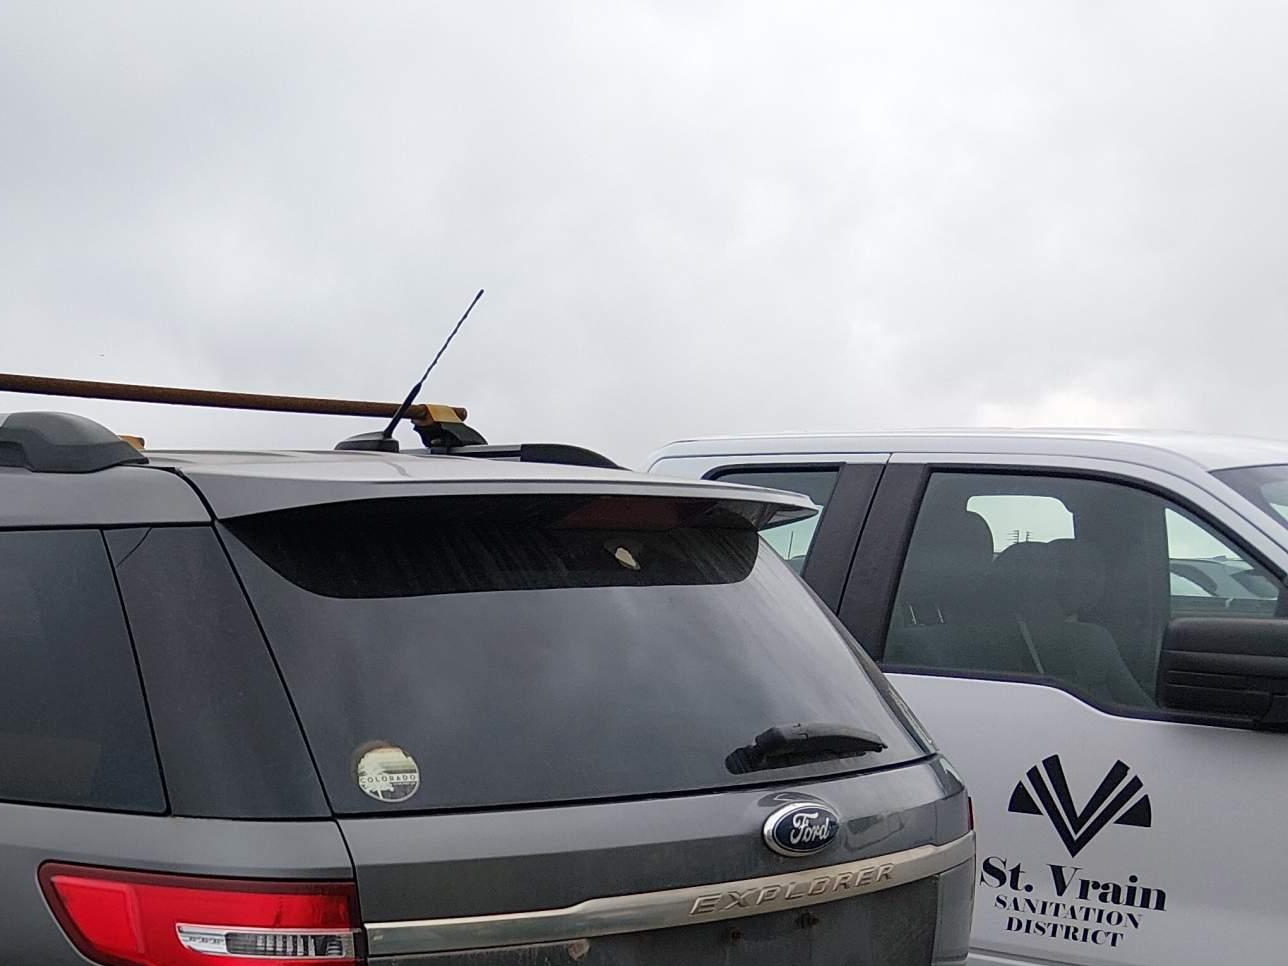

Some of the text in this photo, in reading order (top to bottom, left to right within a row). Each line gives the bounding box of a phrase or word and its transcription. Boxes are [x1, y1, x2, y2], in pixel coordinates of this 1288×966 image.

[360, 774, 416, 784] COLORADO
[790, 812, 831, 845] Ford
[689, 862, 895, 916] EXPLORER
[979, 856, 1167, 912] St. Vrain
[994, 894, 1144, 929] SANITATION
[1004, 917, 1124, 948] DISTRICT
